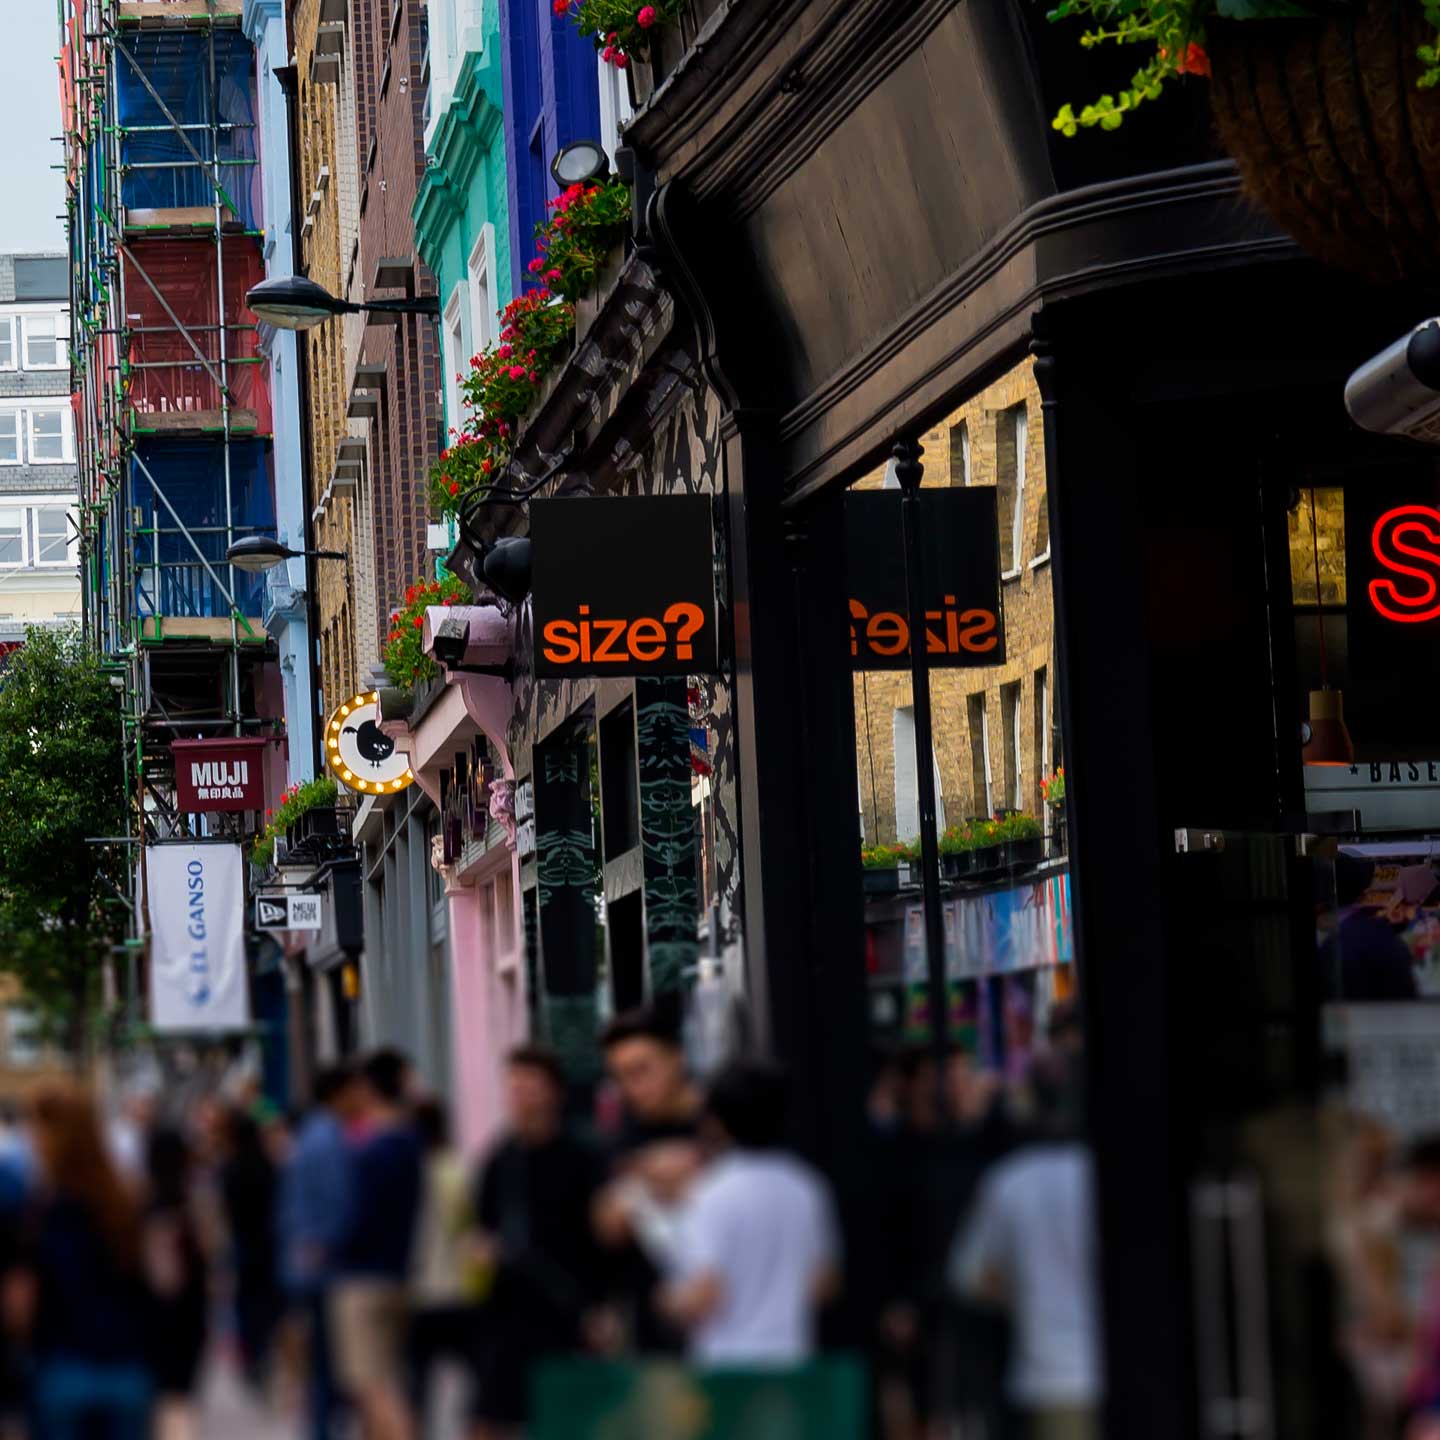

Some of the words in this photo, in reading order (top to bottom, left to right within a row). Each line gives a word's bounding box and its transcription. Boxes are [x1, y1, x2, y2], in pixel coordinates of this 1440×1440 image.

[543, 602, 705, 664] size?
[191, 760, 248, 787] MUJI
[198, 786, 244, 800] 無印良品
[187, 860, 207, 941] GANSO
[293, 902, 316, 912] NEW
[190, 946, 208, 974] EL
